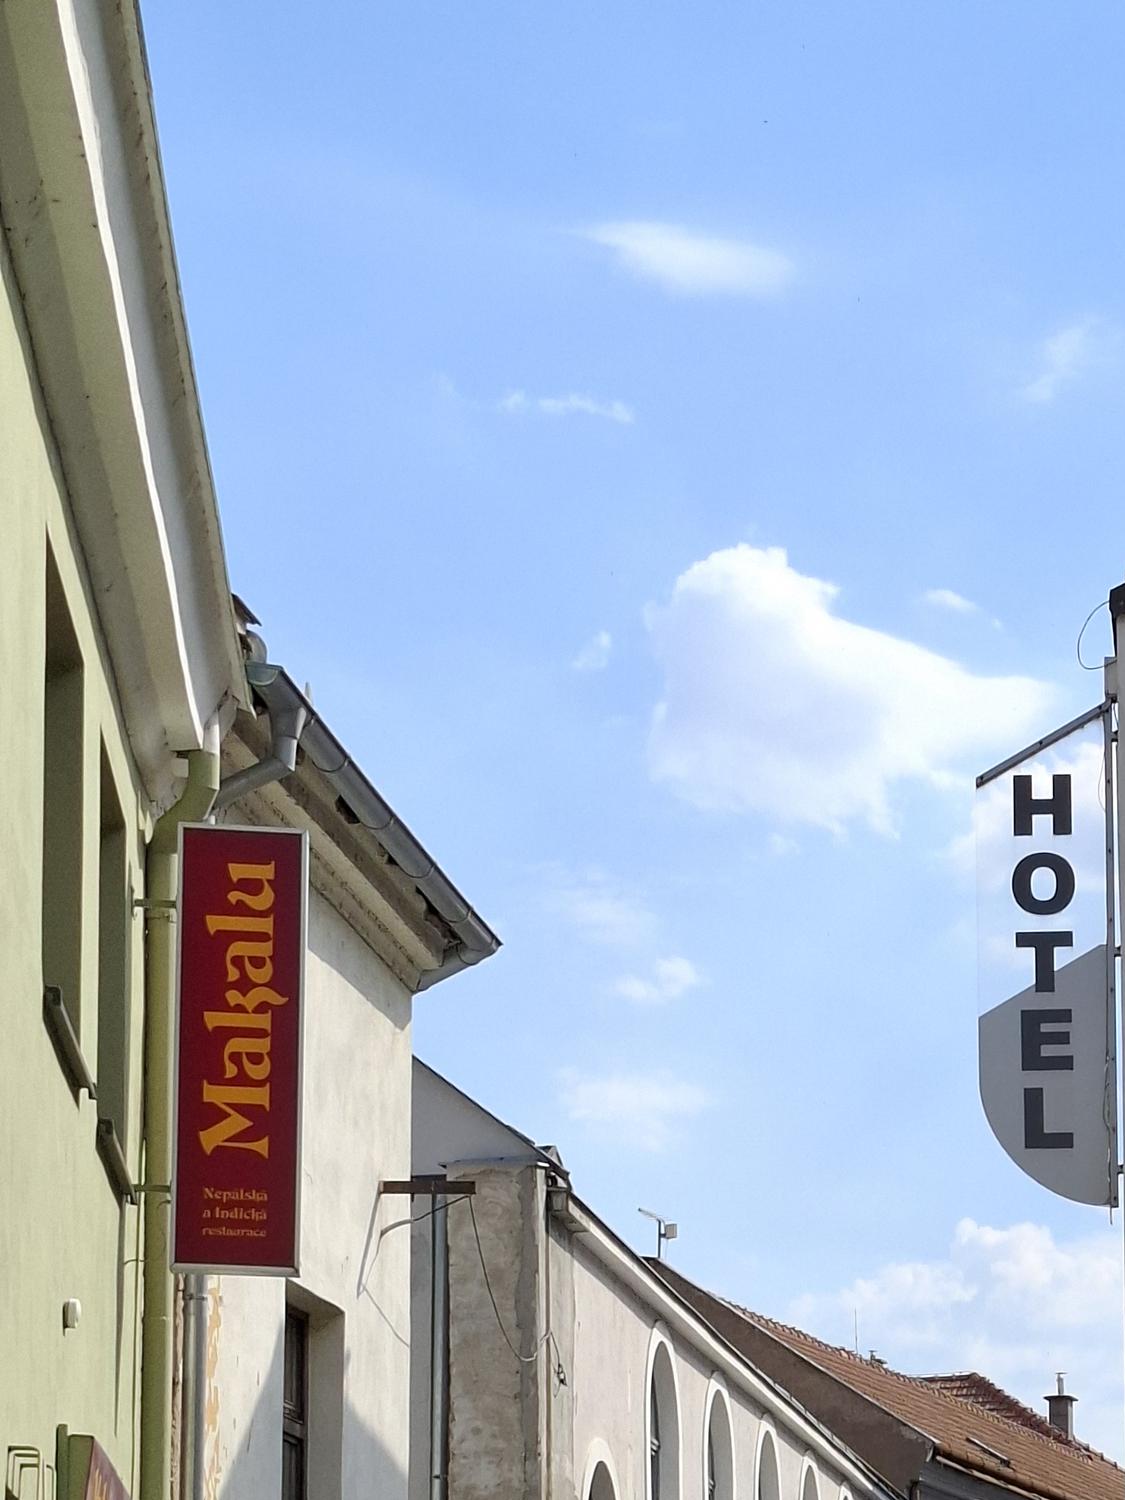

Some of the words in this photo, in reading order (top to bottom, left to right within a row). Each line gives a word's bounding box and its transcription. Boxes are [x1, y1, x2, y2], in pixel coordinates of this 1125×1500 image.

[199, 860, 289, 1159] Makalu
[1011, 774, 1076, 1150] HOTEL
[202, 1226, 267, 1237] restaurace
